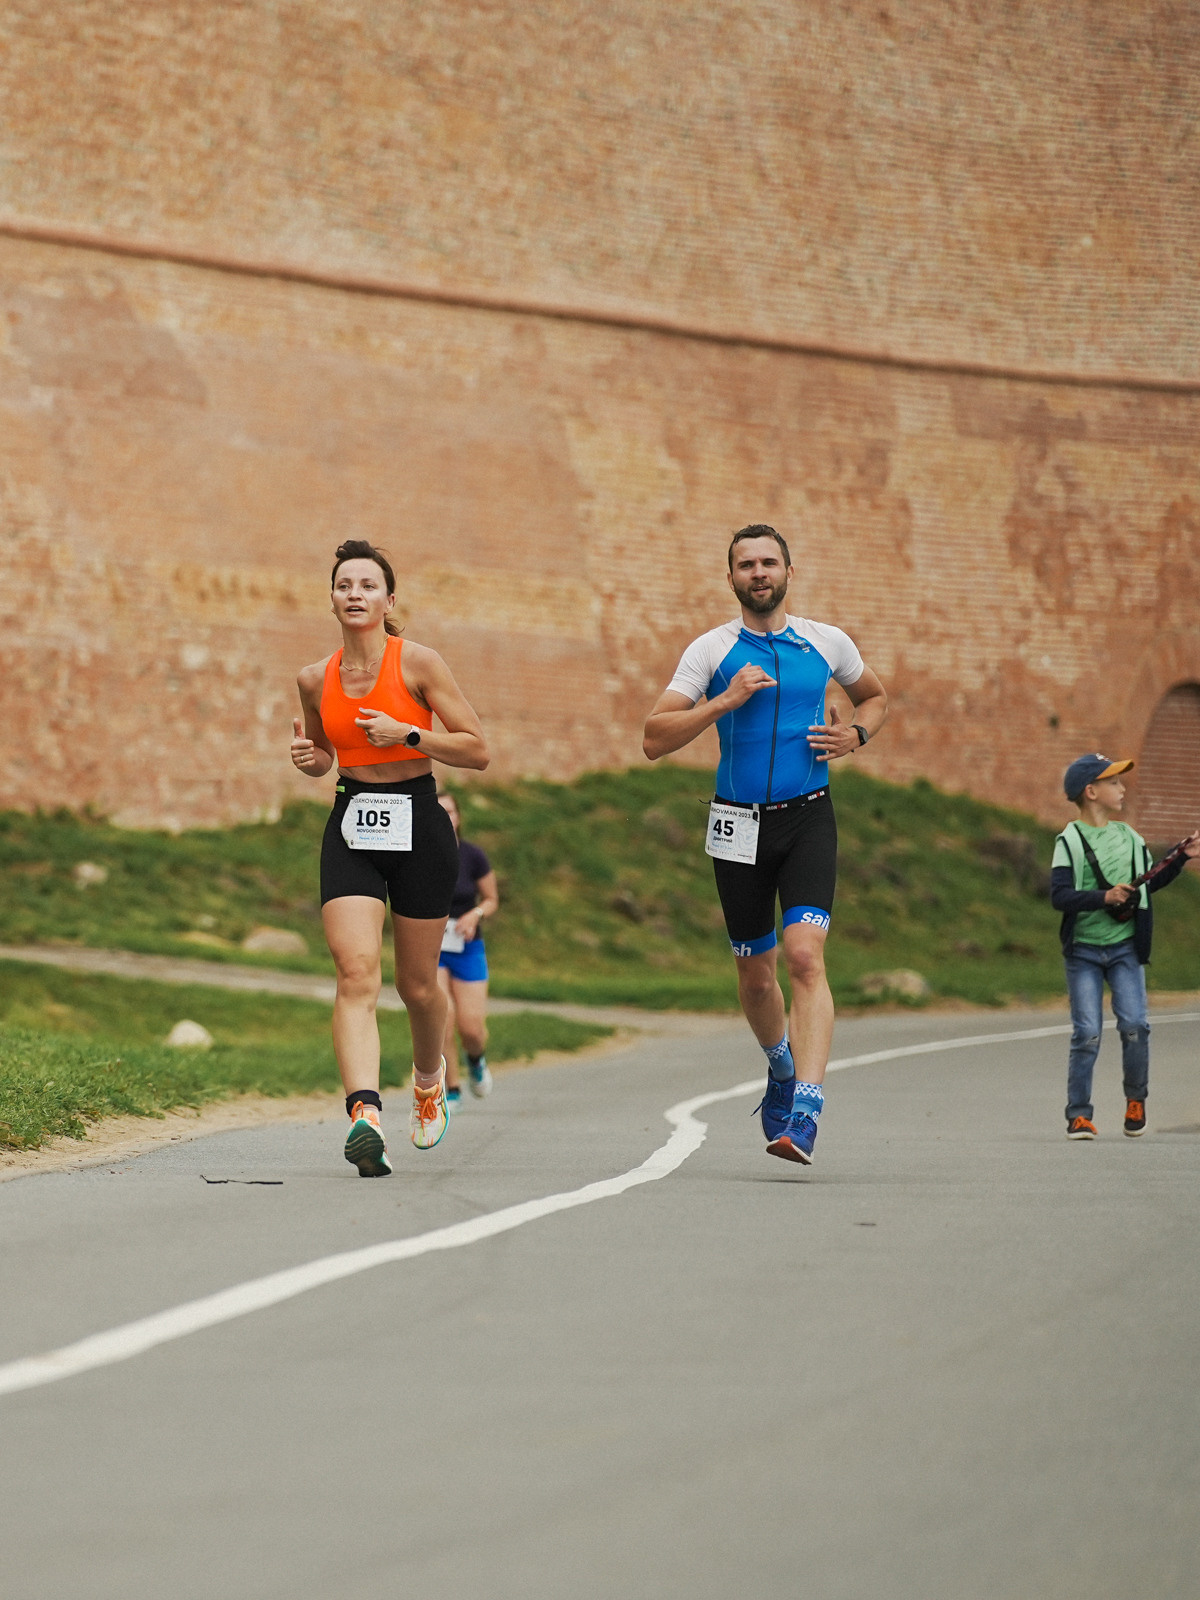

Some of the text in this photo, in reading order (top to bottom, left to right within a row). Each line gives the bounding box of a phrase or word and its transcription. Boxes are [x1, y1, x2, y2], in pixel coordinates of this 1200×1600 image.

[357, 810, 390, 827] 105
[738, 811, 751, 819] 2023
[713, 818, 734, 836] 45
[730, 941, 752, 957] sh
